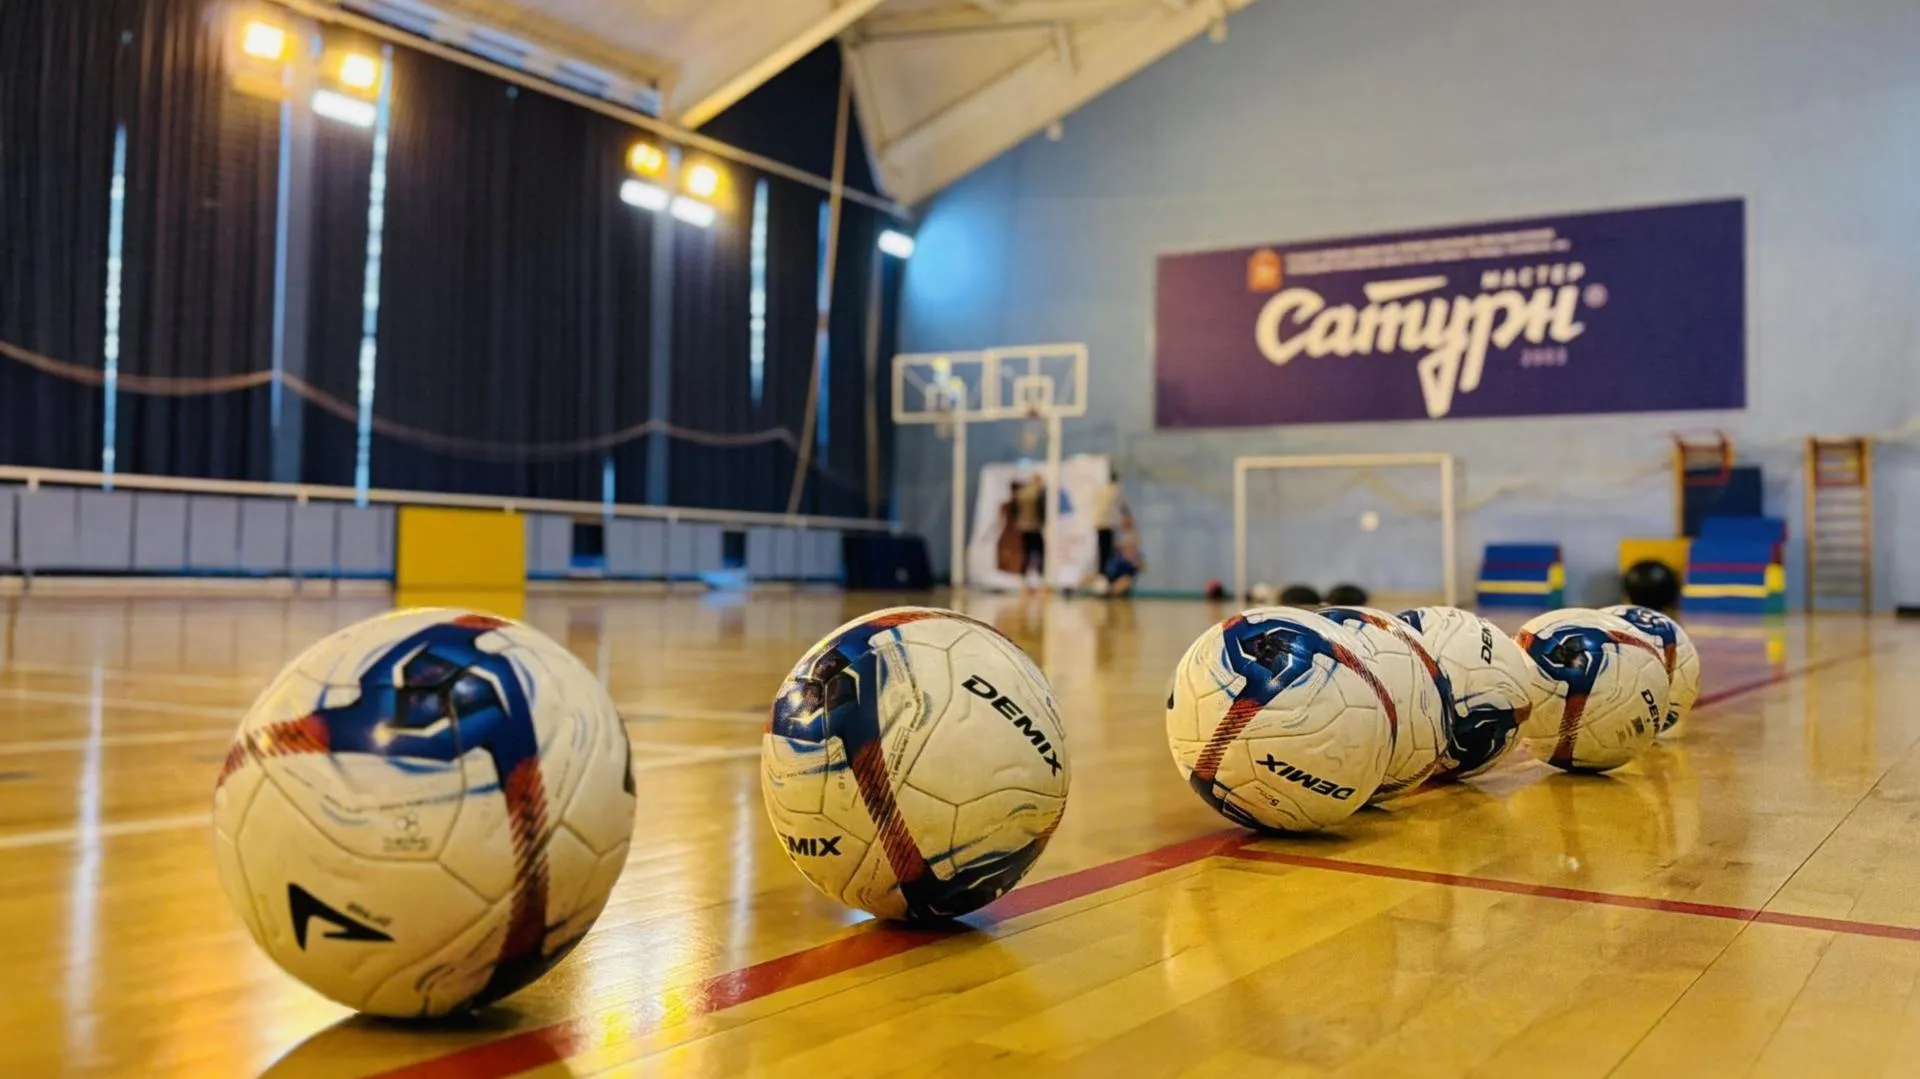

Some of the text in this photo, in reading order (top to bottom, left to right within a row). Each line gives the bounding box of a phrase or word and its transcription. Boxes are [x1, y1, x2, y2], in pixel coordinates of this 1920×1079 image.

[961, 674, 1062, 777] DEMIX
[1255, 753, 1356, 801] DEMIX
[779, 831, 842, 861] MIX
